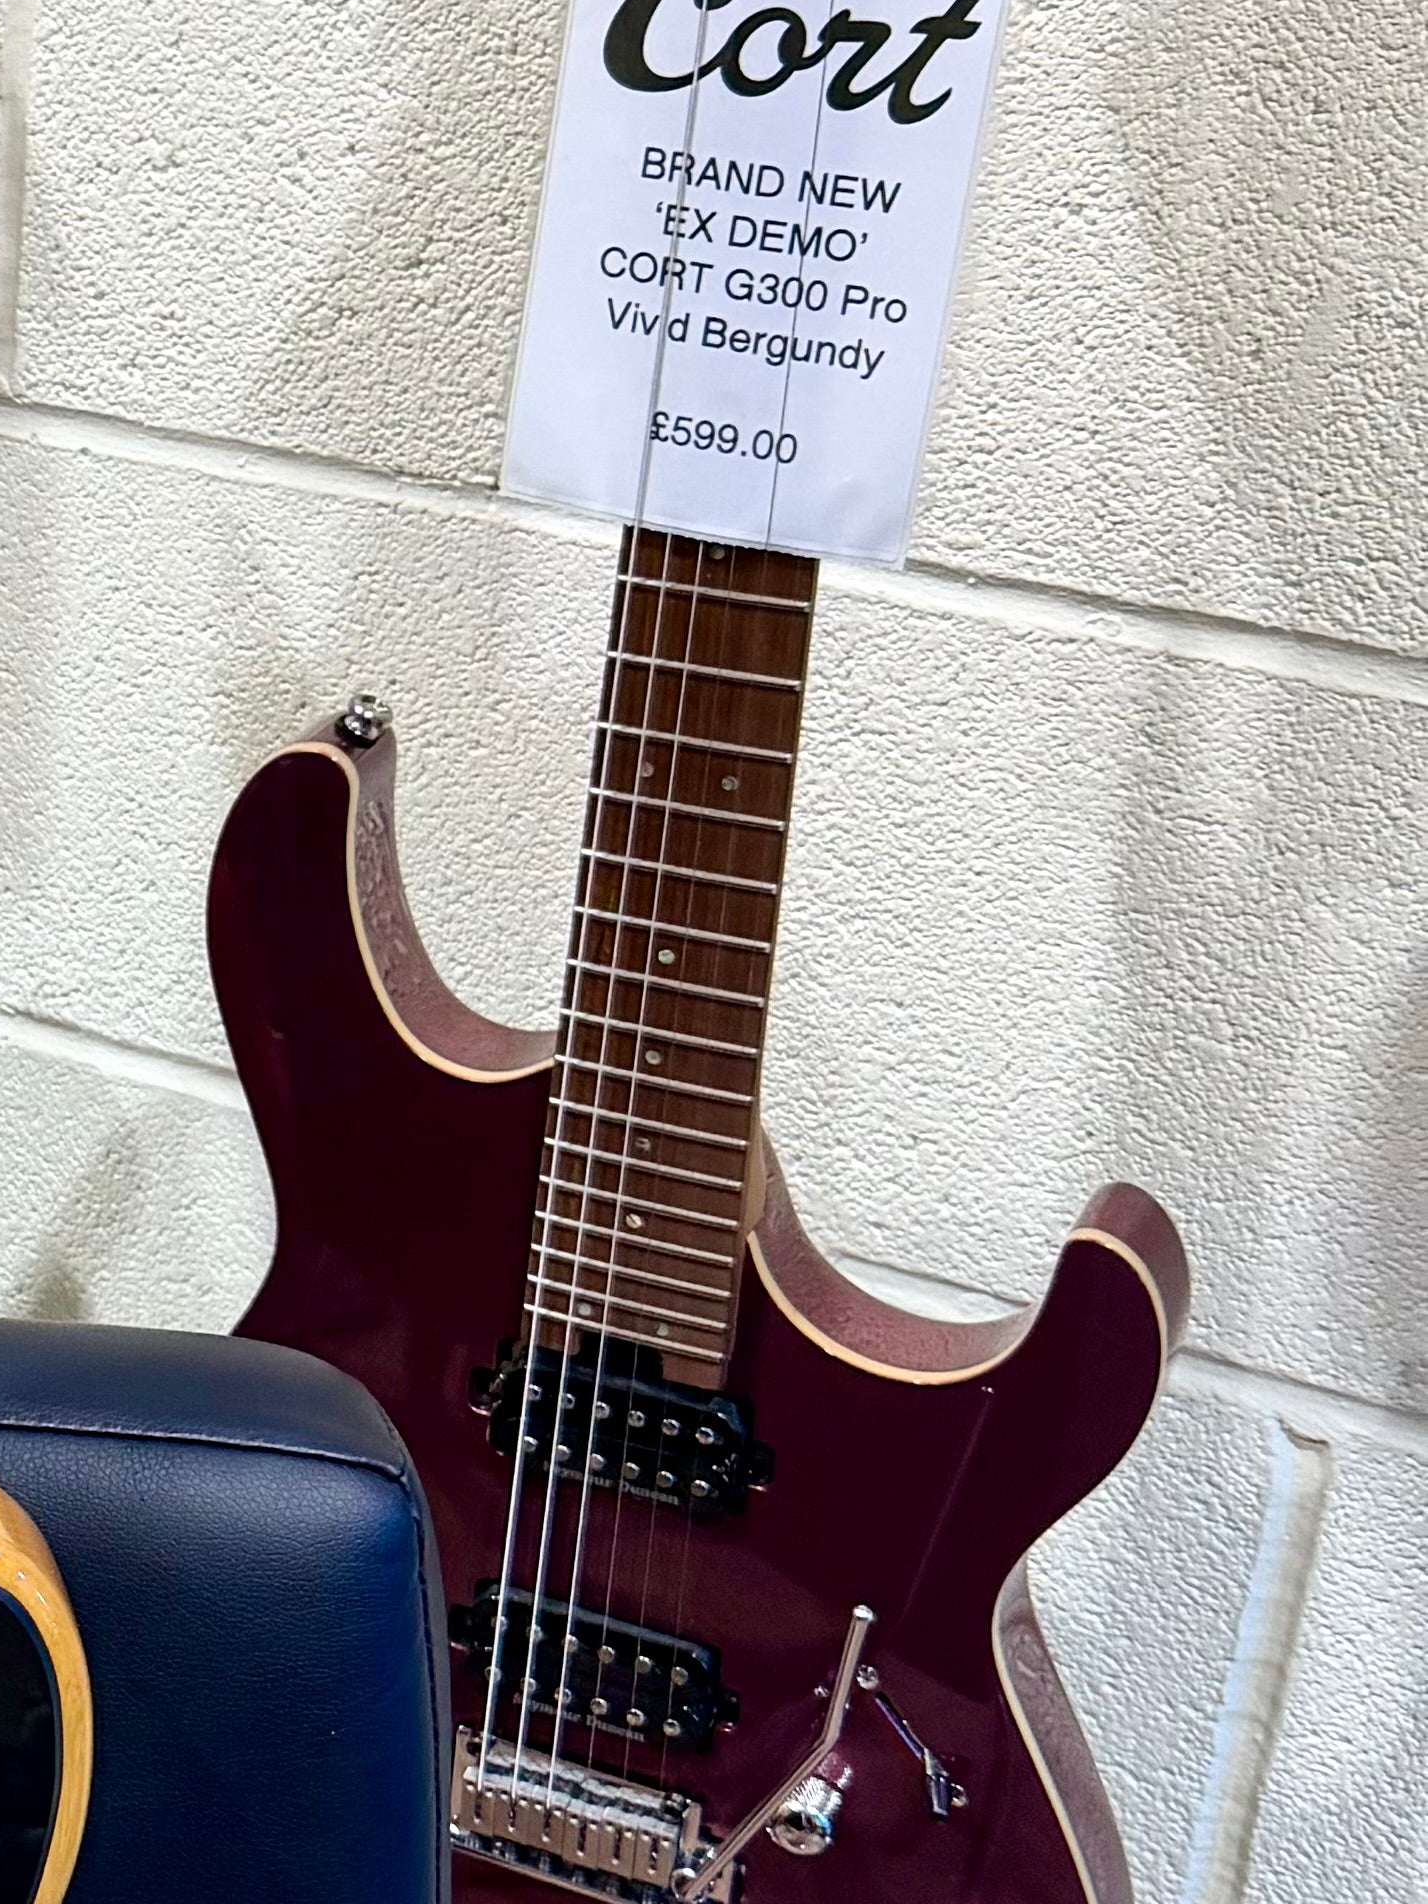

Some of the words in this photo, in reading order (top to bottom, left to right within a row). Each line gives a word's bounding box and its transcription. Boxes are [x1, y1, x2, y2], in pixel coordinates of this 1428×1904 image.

[641, 146, 785, 198] BRAND
[798, 171, 902, 215] NEW
[600, 247, 714, 294] CORT
[724, 267, 829, 313] G300
[840, 285, 908, 325] Pro
[607, 297, 690, 343] Vivd
[701, 315, 886, 380] Bergundy
[649, 410, 798, 464] £599.00
